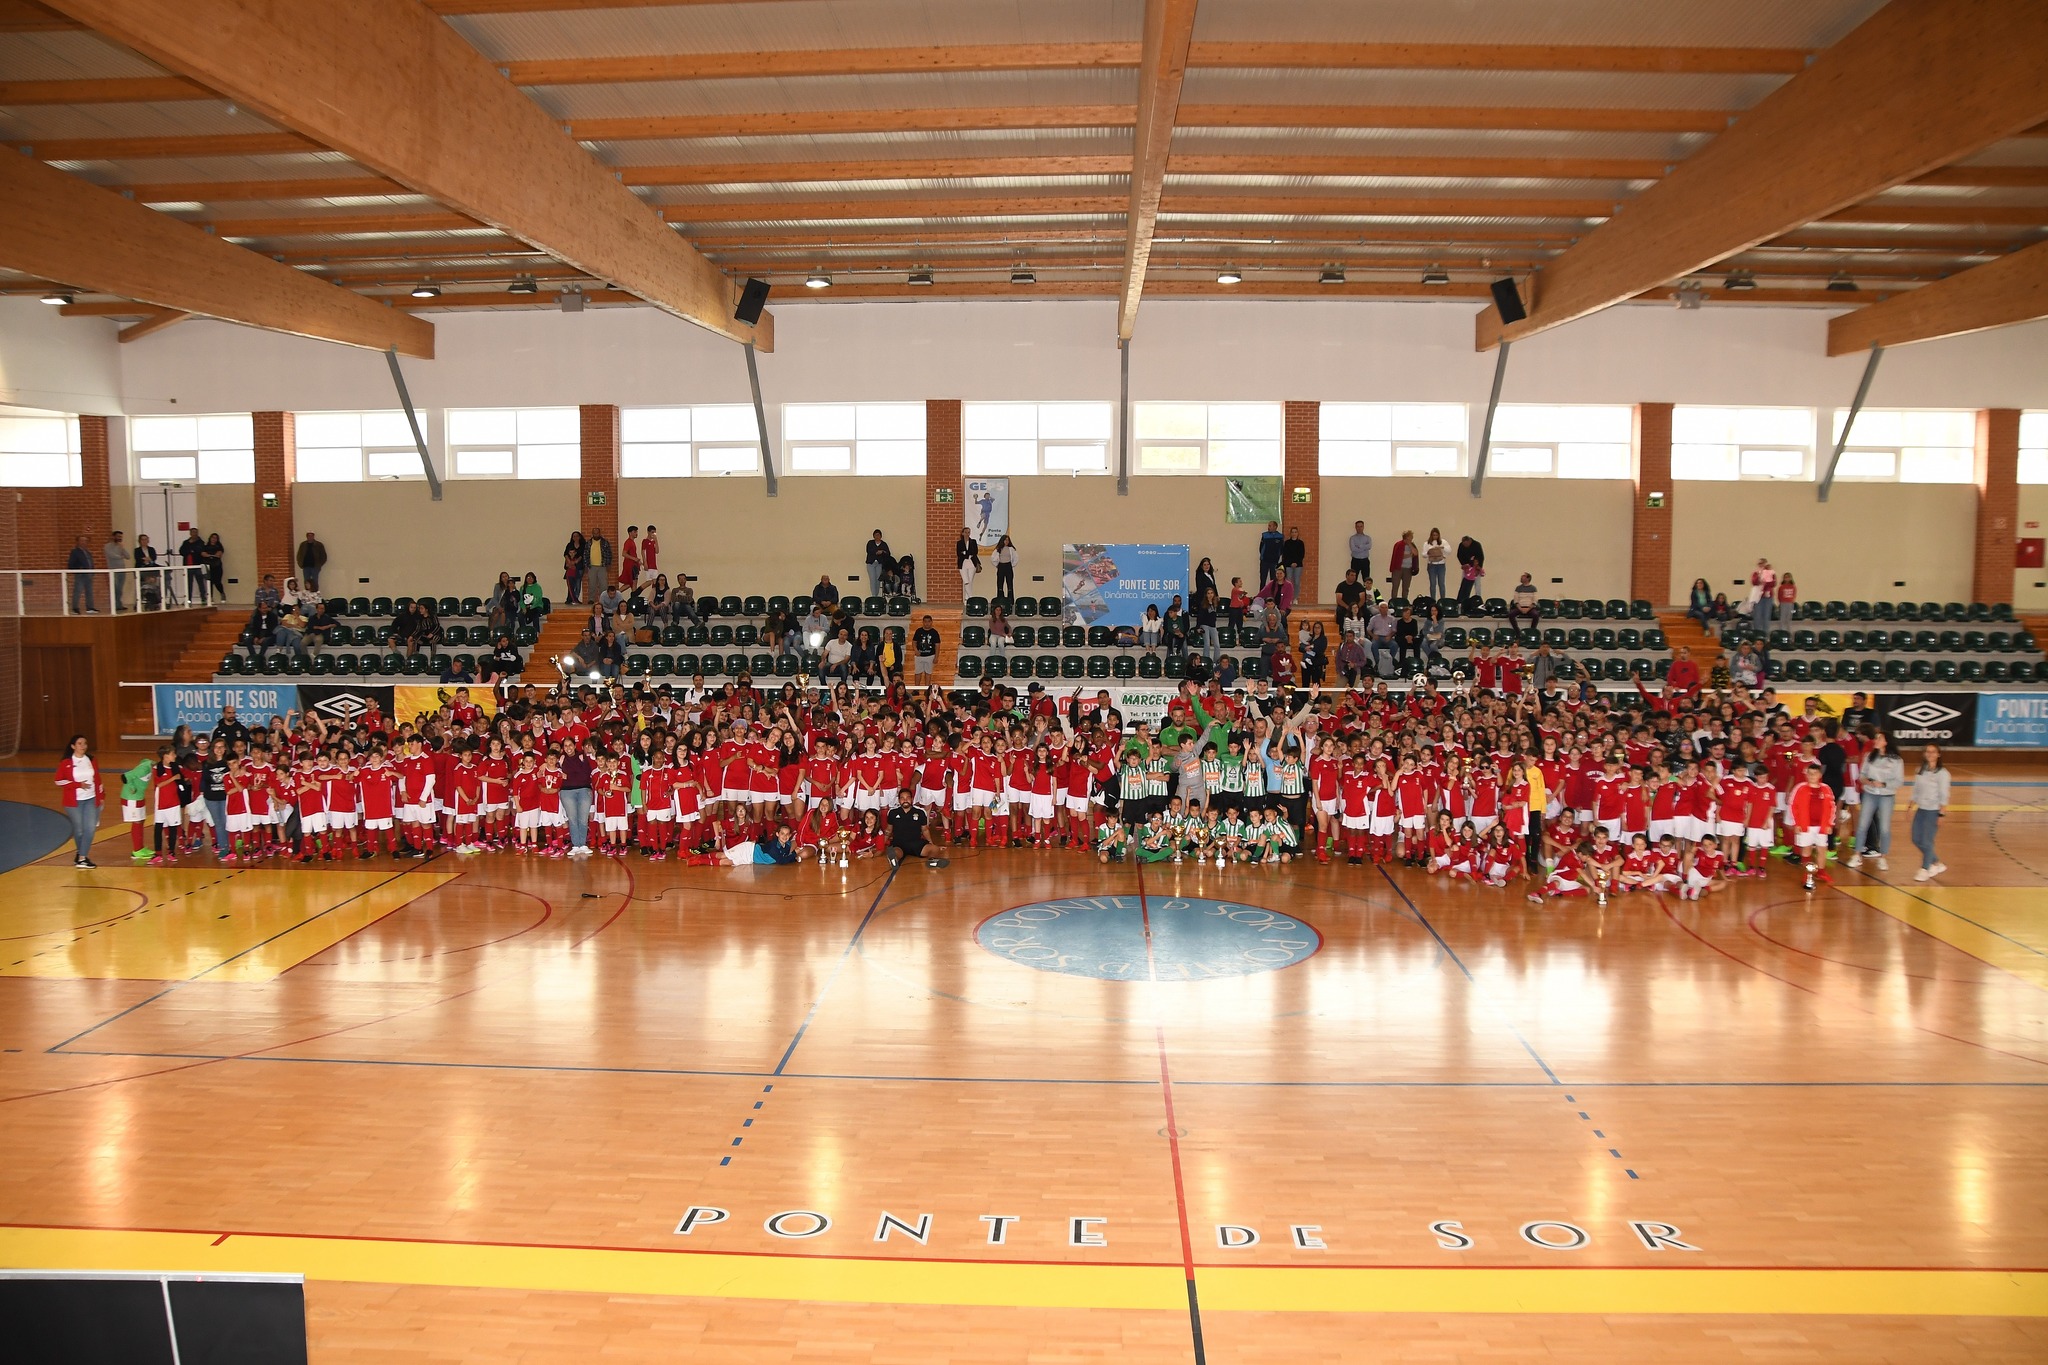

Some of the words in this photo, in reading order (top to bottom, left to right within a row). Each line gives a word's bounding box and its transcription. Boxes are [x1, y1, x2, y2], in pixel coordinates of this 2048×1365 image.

[1119, 579, 1146, 590] PONTE
[1149, 579, 1161, 590] DE
[1163, 579, 1180, 590] SOR
[175, 690, 222, 709] PONTE
[249, 690, 278, 709] SOR
[1996, 699, 2048, 718] PONTE
[1893, 728, 1953, 739] umbro
[992, 896, 1141, 930] PONTE
[1203, 904, 1297, 933] SOR
[992, 936, 1084, 969] SOR
[673, 1205, 1108, 1247] PONTE
[1214, 1223, 1328, 1250] DE
[1428, 1219, 1704, 1251] SOR
